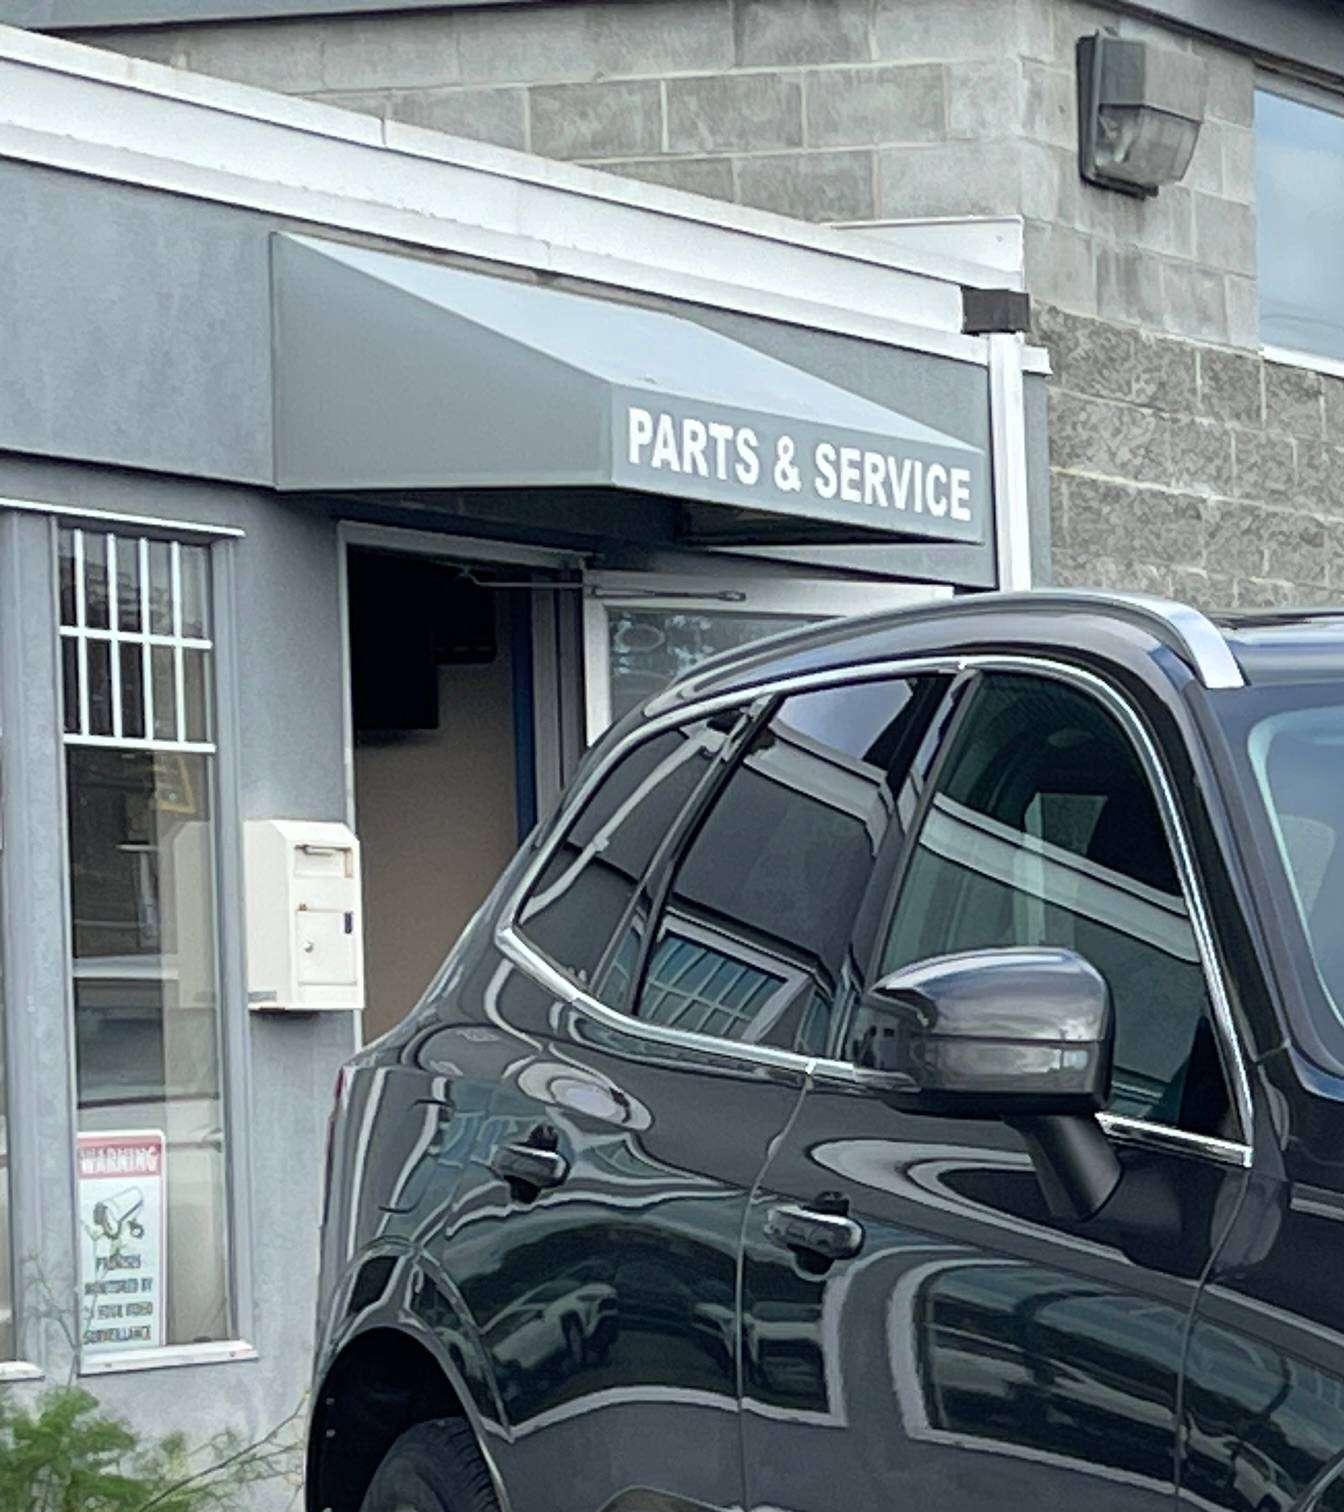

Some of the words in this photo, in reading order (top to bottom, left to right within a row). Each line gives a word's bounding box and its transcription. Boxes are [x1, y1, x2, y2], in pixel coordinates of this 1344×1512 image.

[628, 406, 760, 486] PARTS
[773, 435, 802, 493] &
[814, 442, 973, 522] SERVICE
